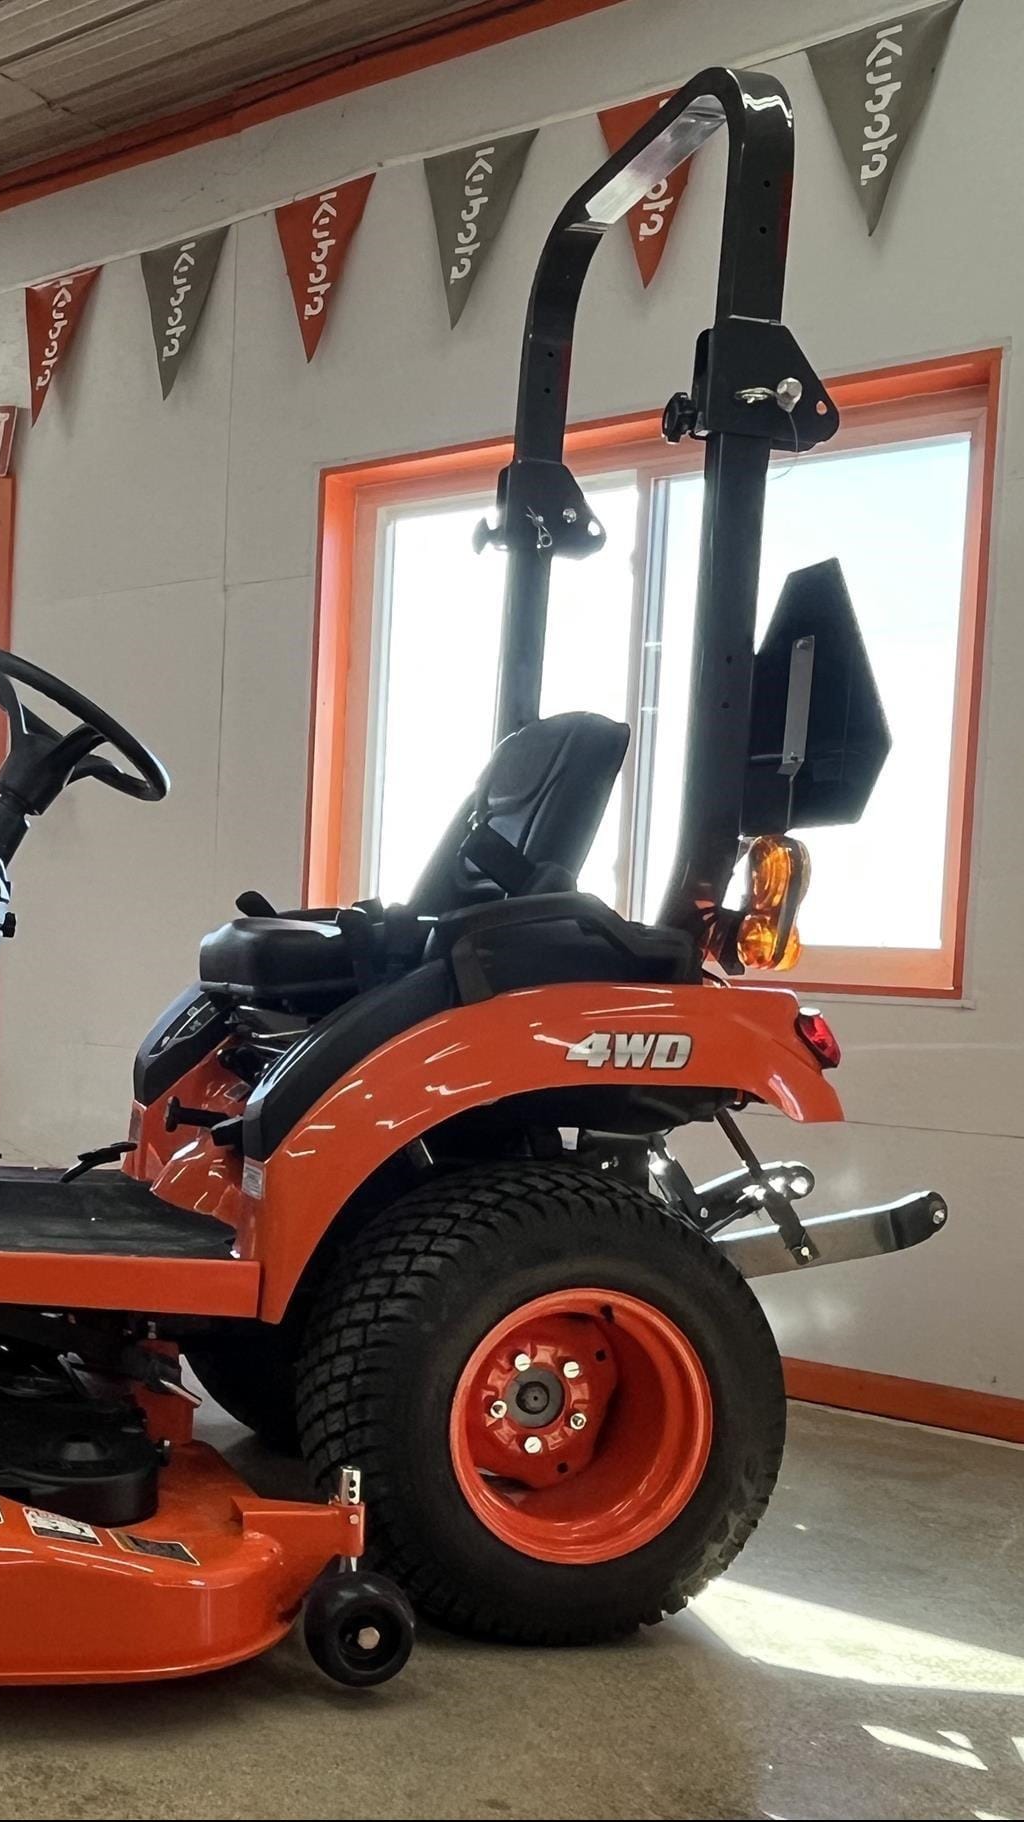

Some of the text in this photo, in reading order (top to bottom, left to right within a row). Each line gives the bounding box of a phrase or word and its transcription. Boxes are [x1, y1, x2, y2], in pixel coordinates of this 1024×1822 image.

[860, 23, 903, 186] Kubota
[304, 191, 337, 320] Kubota
[449, 146, 495, 285] Kubota
[638, 178, 675, 241] ota
[36, 279, 74, 391] Kubota
[162, 242, 196, 361] Kubota
[566, 1032, 692, 1069] 4WD
